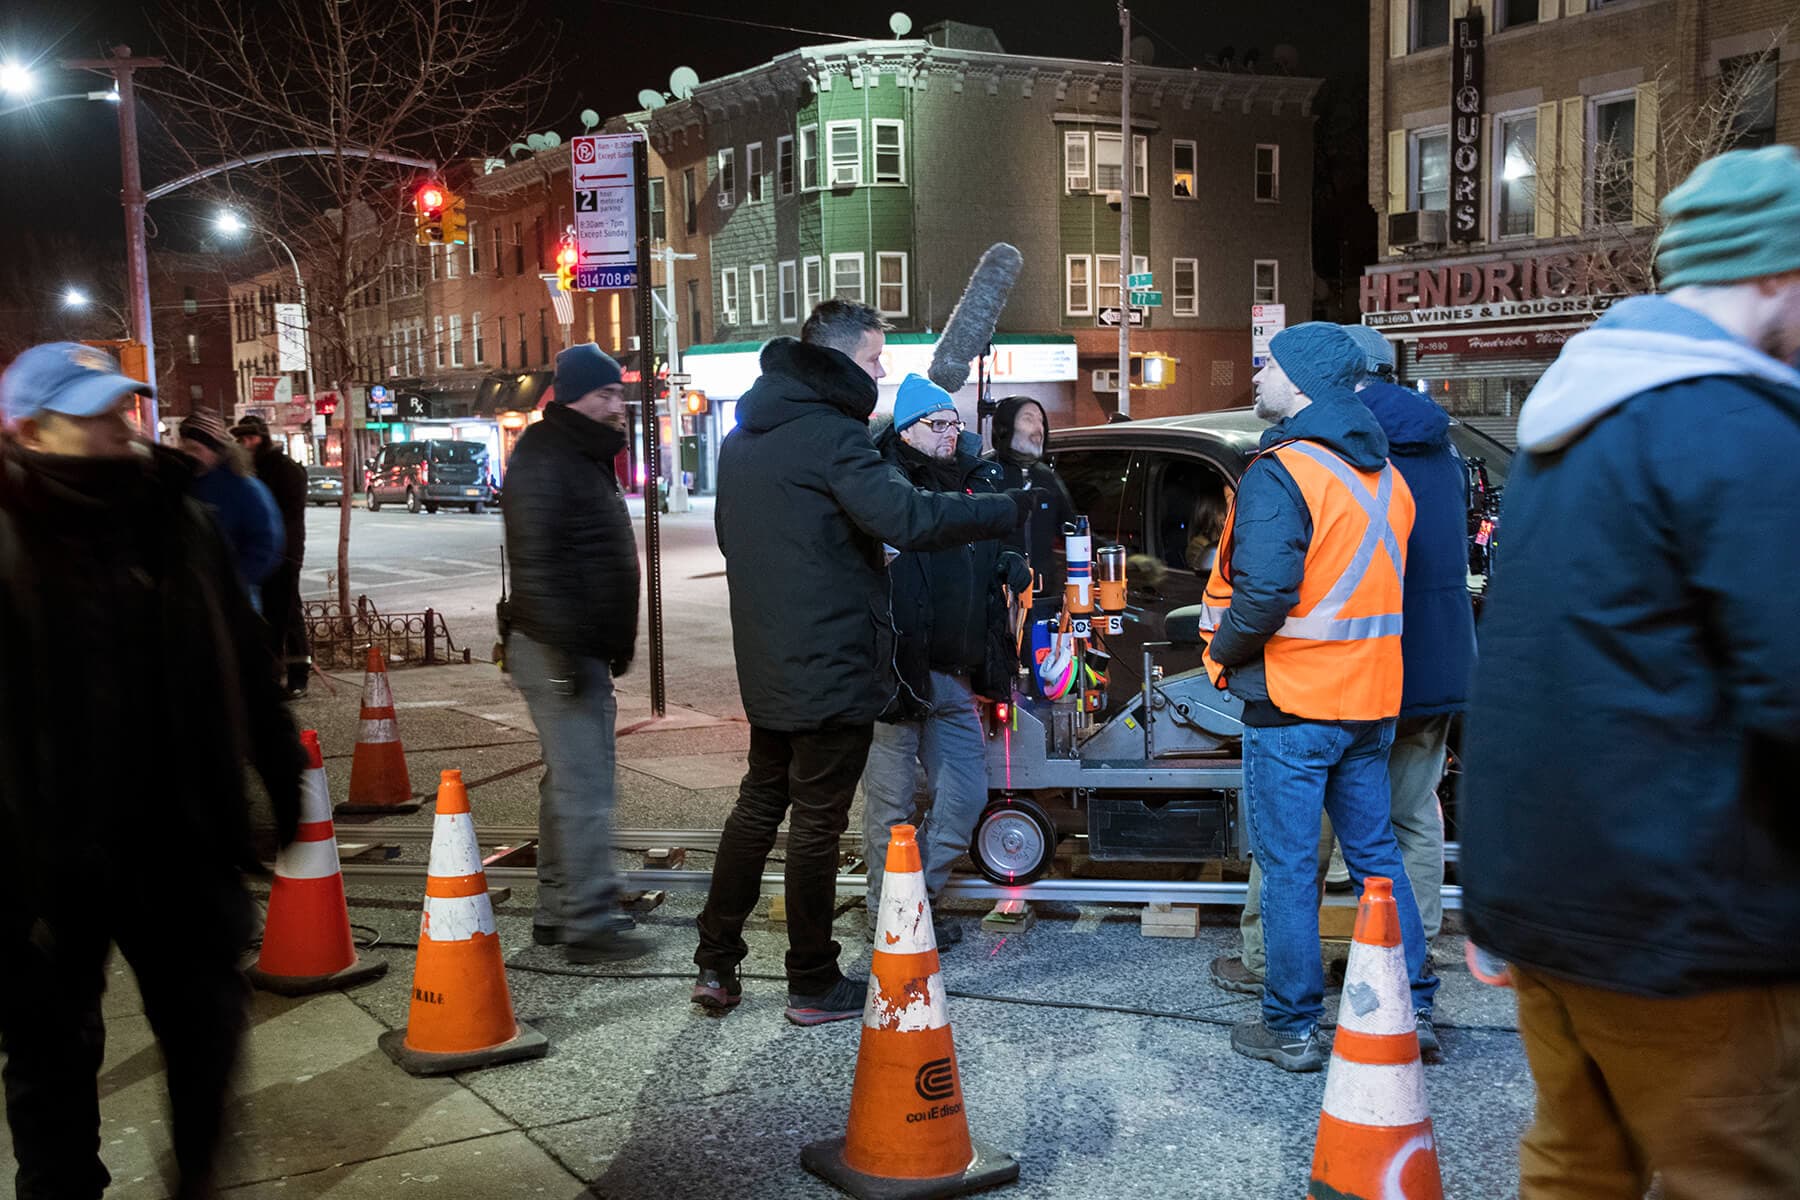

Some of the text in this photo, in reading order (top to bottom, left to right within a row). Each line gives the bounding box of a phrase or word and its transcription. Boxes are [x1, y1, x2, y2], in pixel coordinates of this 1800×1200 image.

[1455, 22, 1480, 231] LIQUORS
[580, 190, 593, 211] 2
[580, 228, 629, 239] Except Sunday
[580, 272, 622, 287] 314708
[1416, 308, 1474, 323] WINES
[1480, 306, 1493, 318] &
[1500, 299, 1588, 317] LIQUORS
